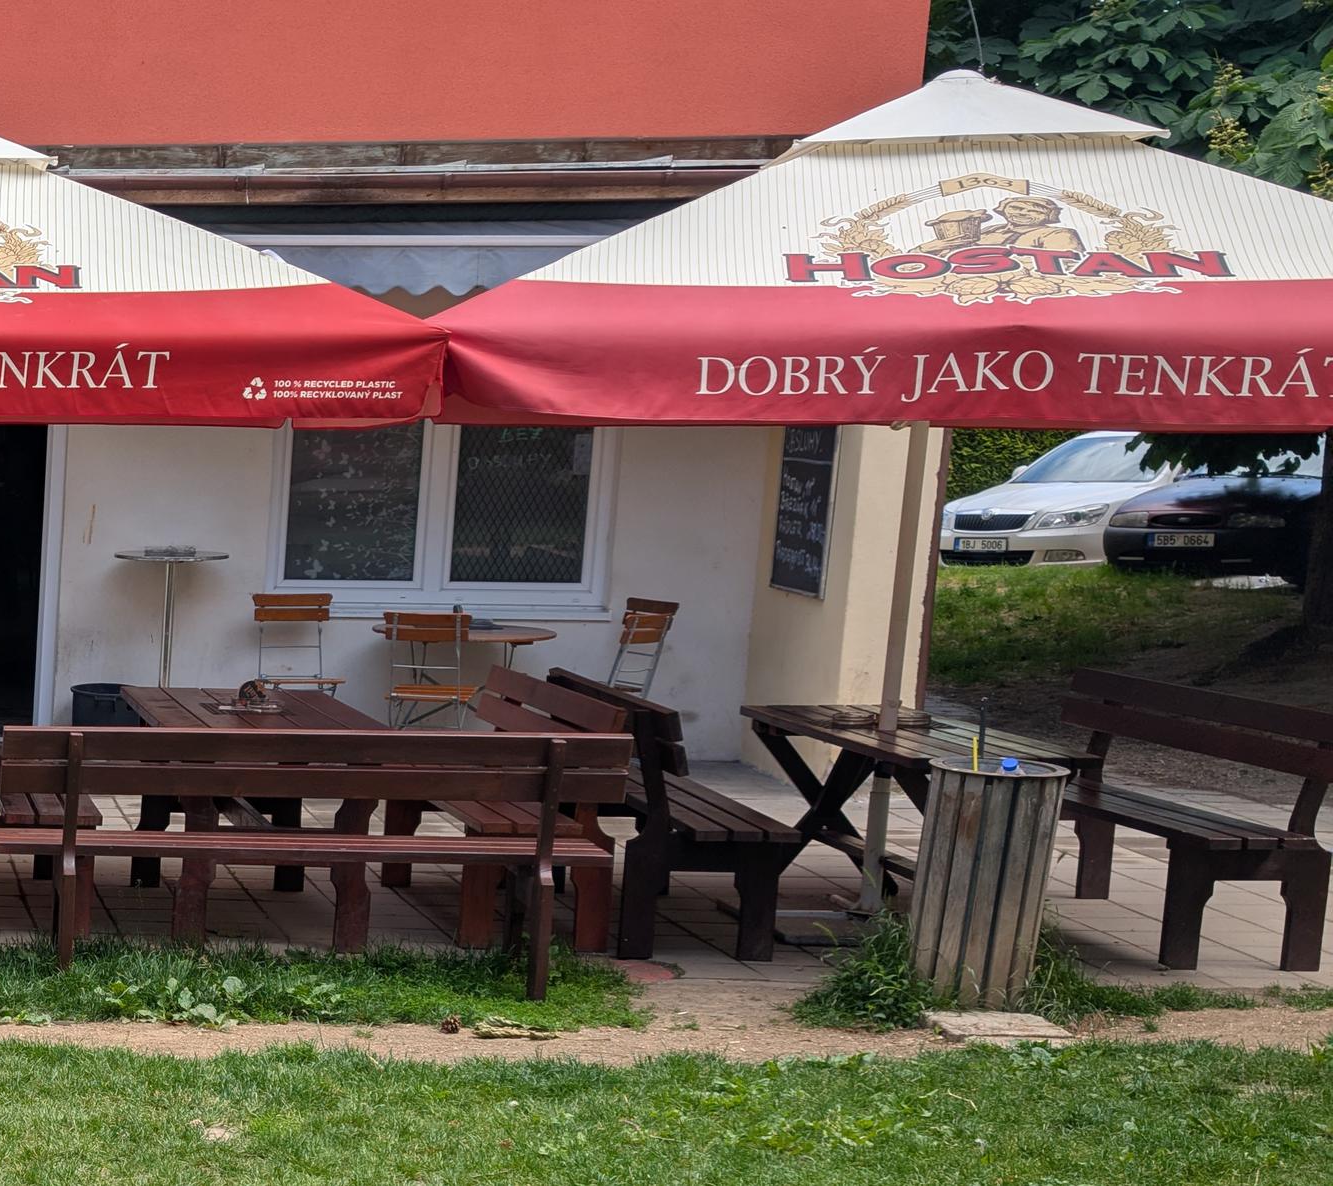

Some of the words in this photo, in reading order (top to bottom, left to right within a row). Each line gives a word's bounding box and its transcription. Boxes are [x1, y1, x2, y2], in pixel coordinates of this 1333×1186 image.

[956, 175, 1014, 190] 1363
[695, 347, 886, 396] DOBRÝ
[901, 349, 1055, 403] JAKO
[1078, 348, 1333, 398] TENKRÁ
[274, 379, 292, 388] 100
[293, 380, 302, 388] %
[303, 380, 354, 388] RECYCLED
[355, 380, 396, 389] PLASTIC
[272, 390, 298, 399] 100%
[299, 389, 371, 399] RECYKLOVANÝ
[372, 391, 404, 400] PLAST
[981, 540, 1003, 549] 5006
[1183, 535, 1210, 546] 0664
